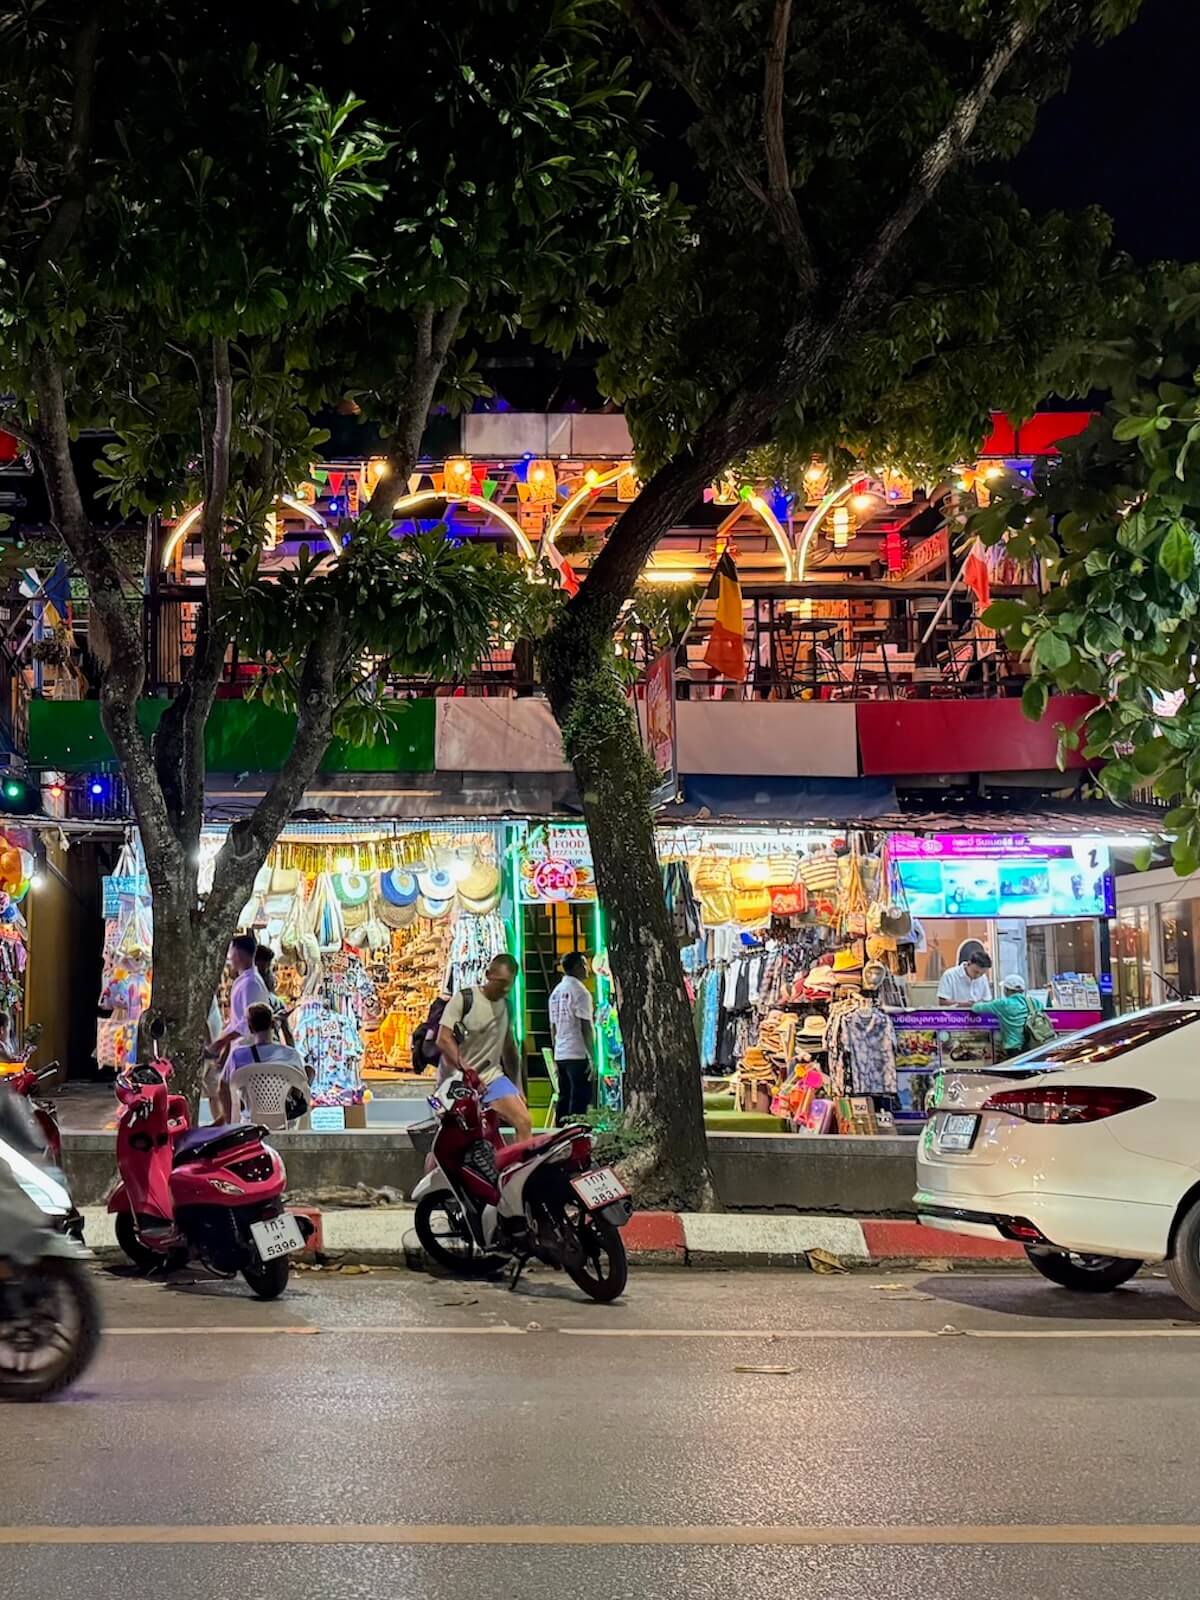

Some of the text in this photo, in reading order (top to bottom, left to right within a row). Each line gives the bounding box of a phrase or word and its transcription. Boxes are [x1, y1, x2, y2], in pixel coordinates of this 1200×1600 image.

[555, 840, 584, 849] FOOD
[537, 873, 574, 888] OPEN
[592, 1188, 620, 1205] 3831
[267, 1239, 297, 1256] 5396
